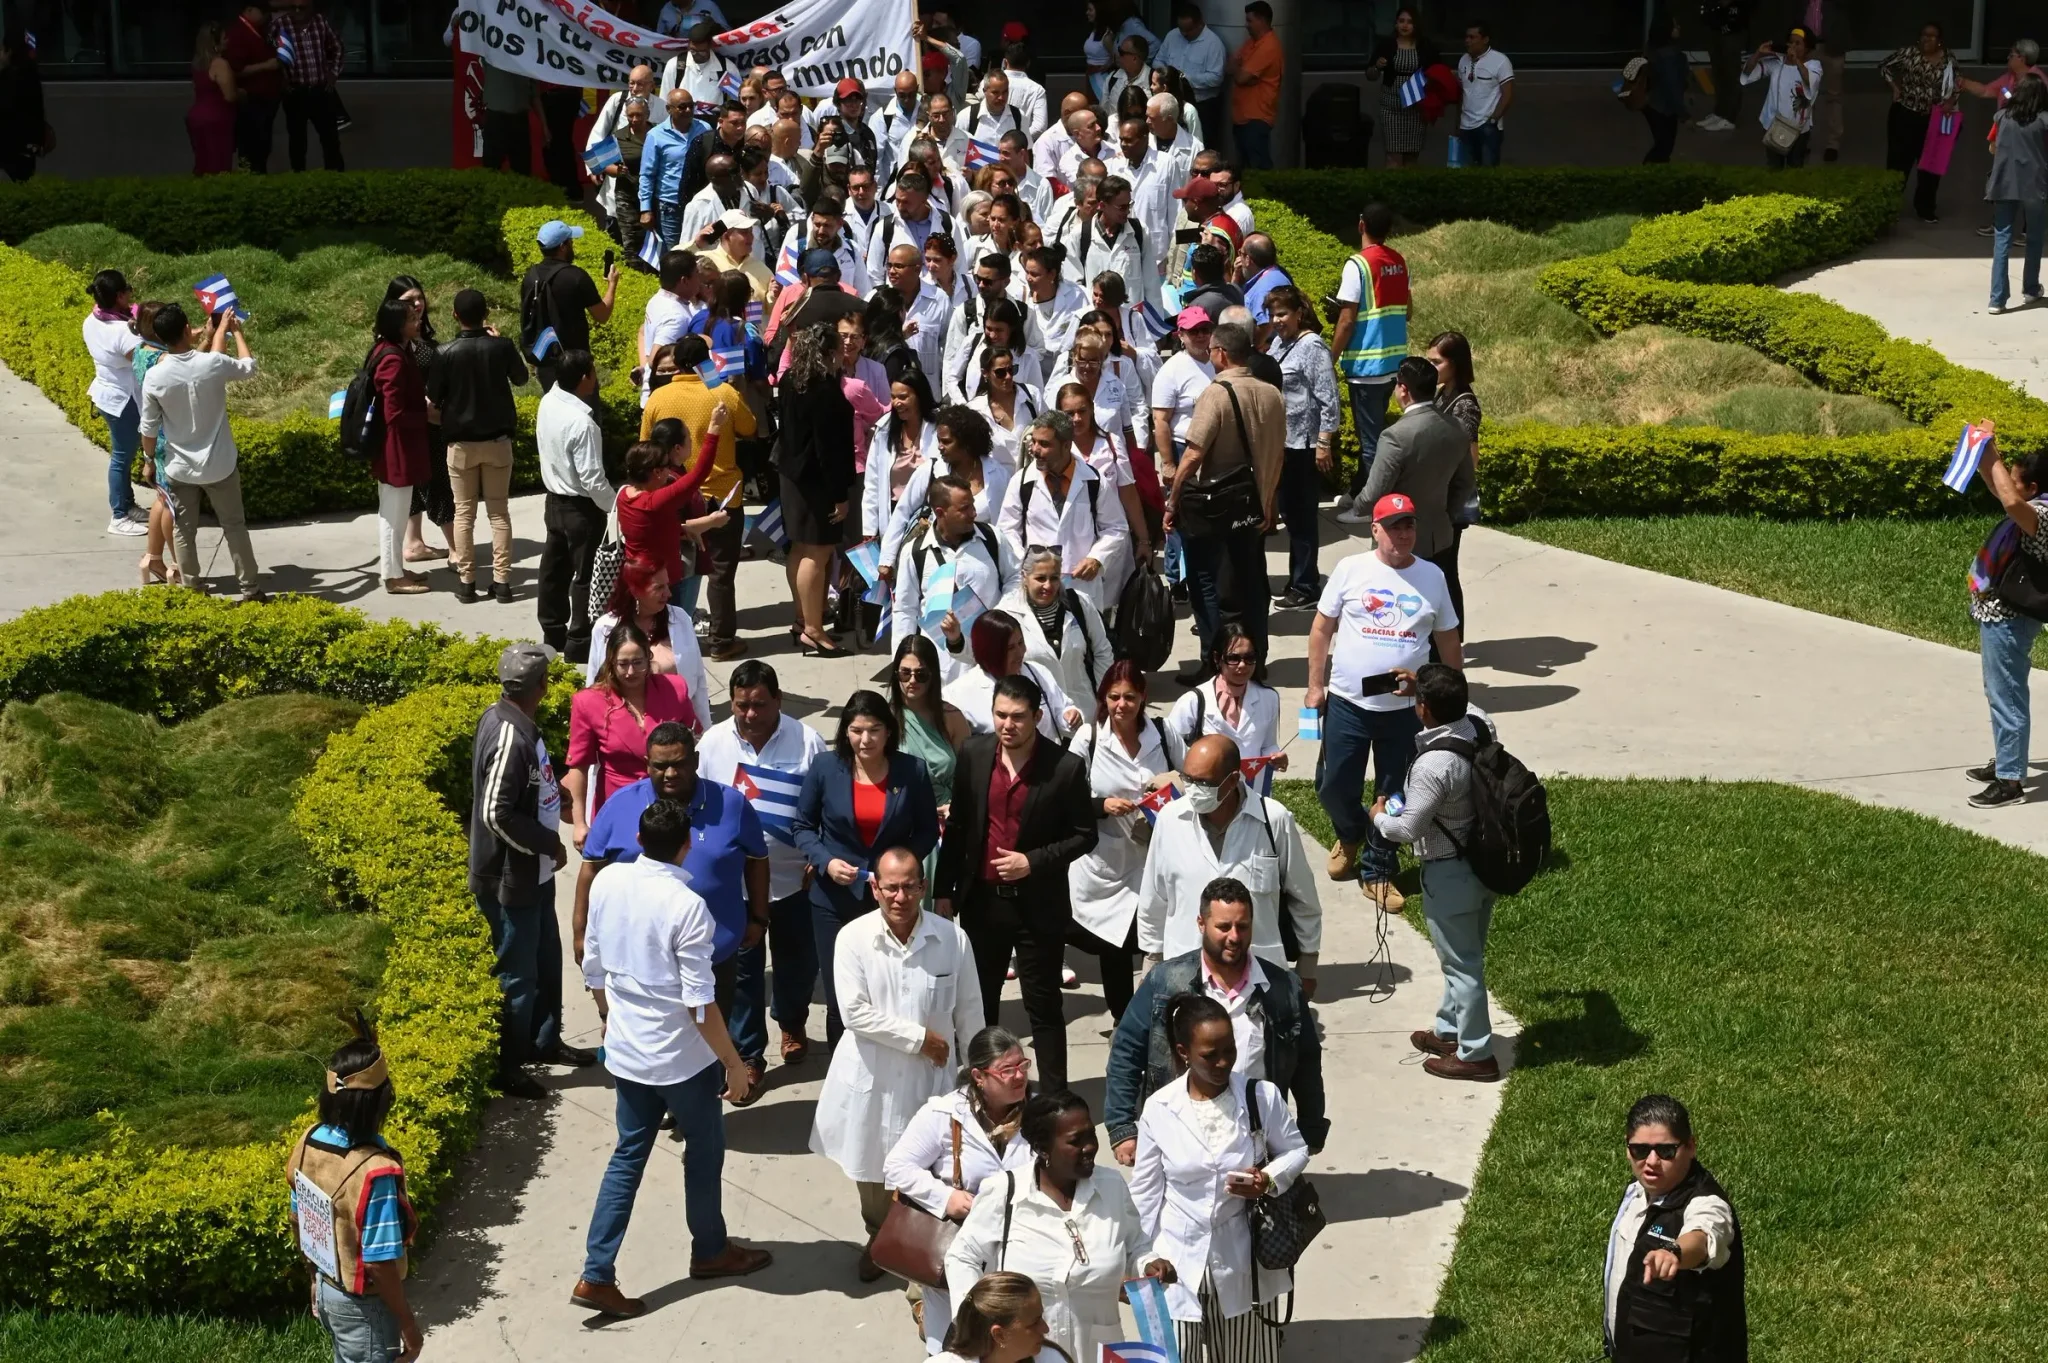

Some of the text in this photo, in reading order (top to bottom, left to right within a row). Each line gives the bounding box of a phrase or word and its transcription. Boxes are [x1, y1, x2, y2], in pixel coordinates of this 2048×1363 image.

[536, 38, 586, 76] los
[559, 22, 593, 52] tu
[799, 24, 847, 57] con
[1362, 628, 1396, 636] GRACIAS
[295, 1179, 330, 1216] GRACIAS
[296, 1192, 332, 1225] HERMANOS
[297, 1200, 333, 1237] CUBANOS
[303, 1221, 330, 1250] APORTE
[301, 1240, 336, 1275] HONDURAS
